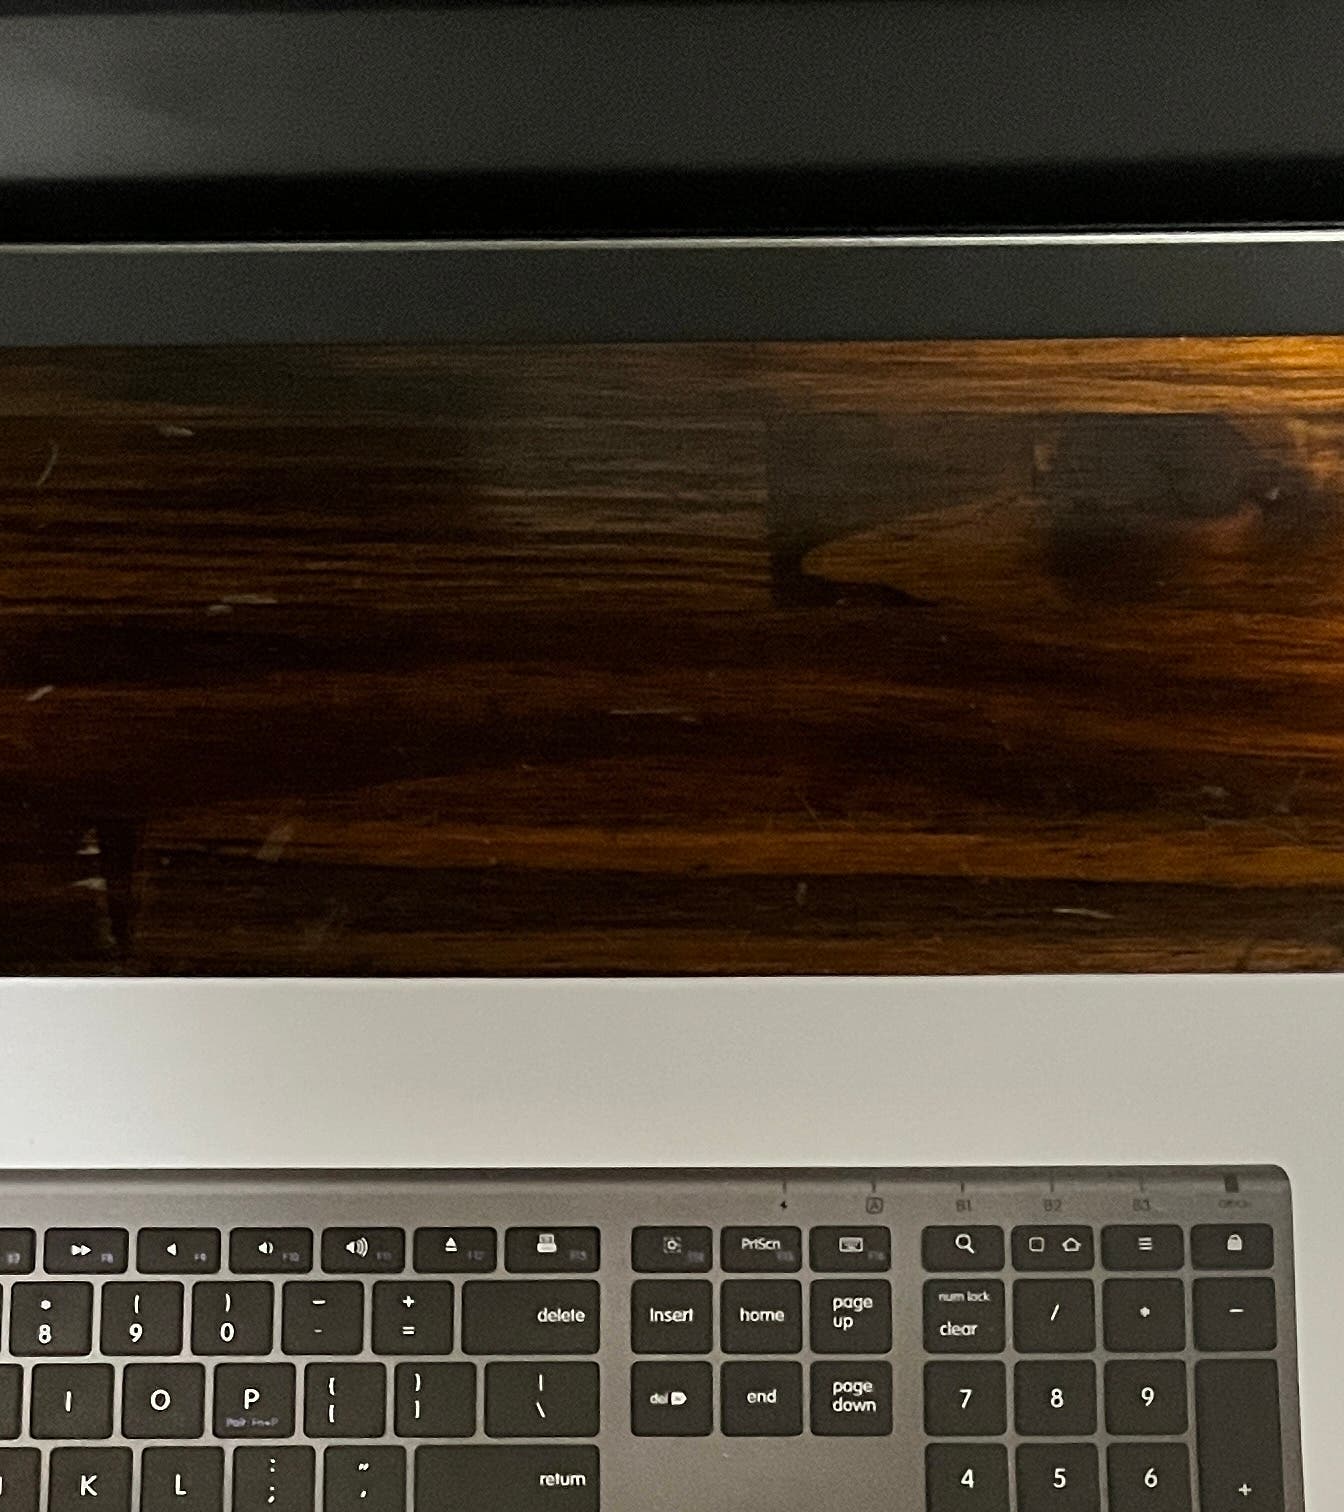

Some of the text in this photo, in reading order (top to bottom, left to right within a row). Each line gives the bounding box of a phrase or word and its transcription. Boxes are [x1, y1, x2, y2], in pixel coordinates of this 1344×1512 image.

[832, 1297, 873, 1313] page
[937, 1289, 991, 1303] num lock
[537, 1307, 586, 1323] delete
[739, 1307, 785, 1322] home
[832, 1316, 854, 1332] up
[38, 1324, 52, 1344] 8
[129, 1323, 143, 1343] 9
[939, 1320, 978, 1336] clear
[244, 1388, 260, 1410] P
[746, 1388, 777, 1404] end
[832, 1381, 873, 1399] page
[959, 1388, 973, 1409] 7
[1050, 1388, 1064, 1409] 8
[1141, 1386, 1155, 1407] 9
[832, 1396, 877, 1412] down
[80, 1474, 98, 1497] K
[175, 1473, 187, 1496] L
[539, 1472, 586, 1487] return
[960, 1468, 975, 1489] 4
[1053, 1467, 1067, 1489] 5
[1144, 1467, 1158, 1488] 6
